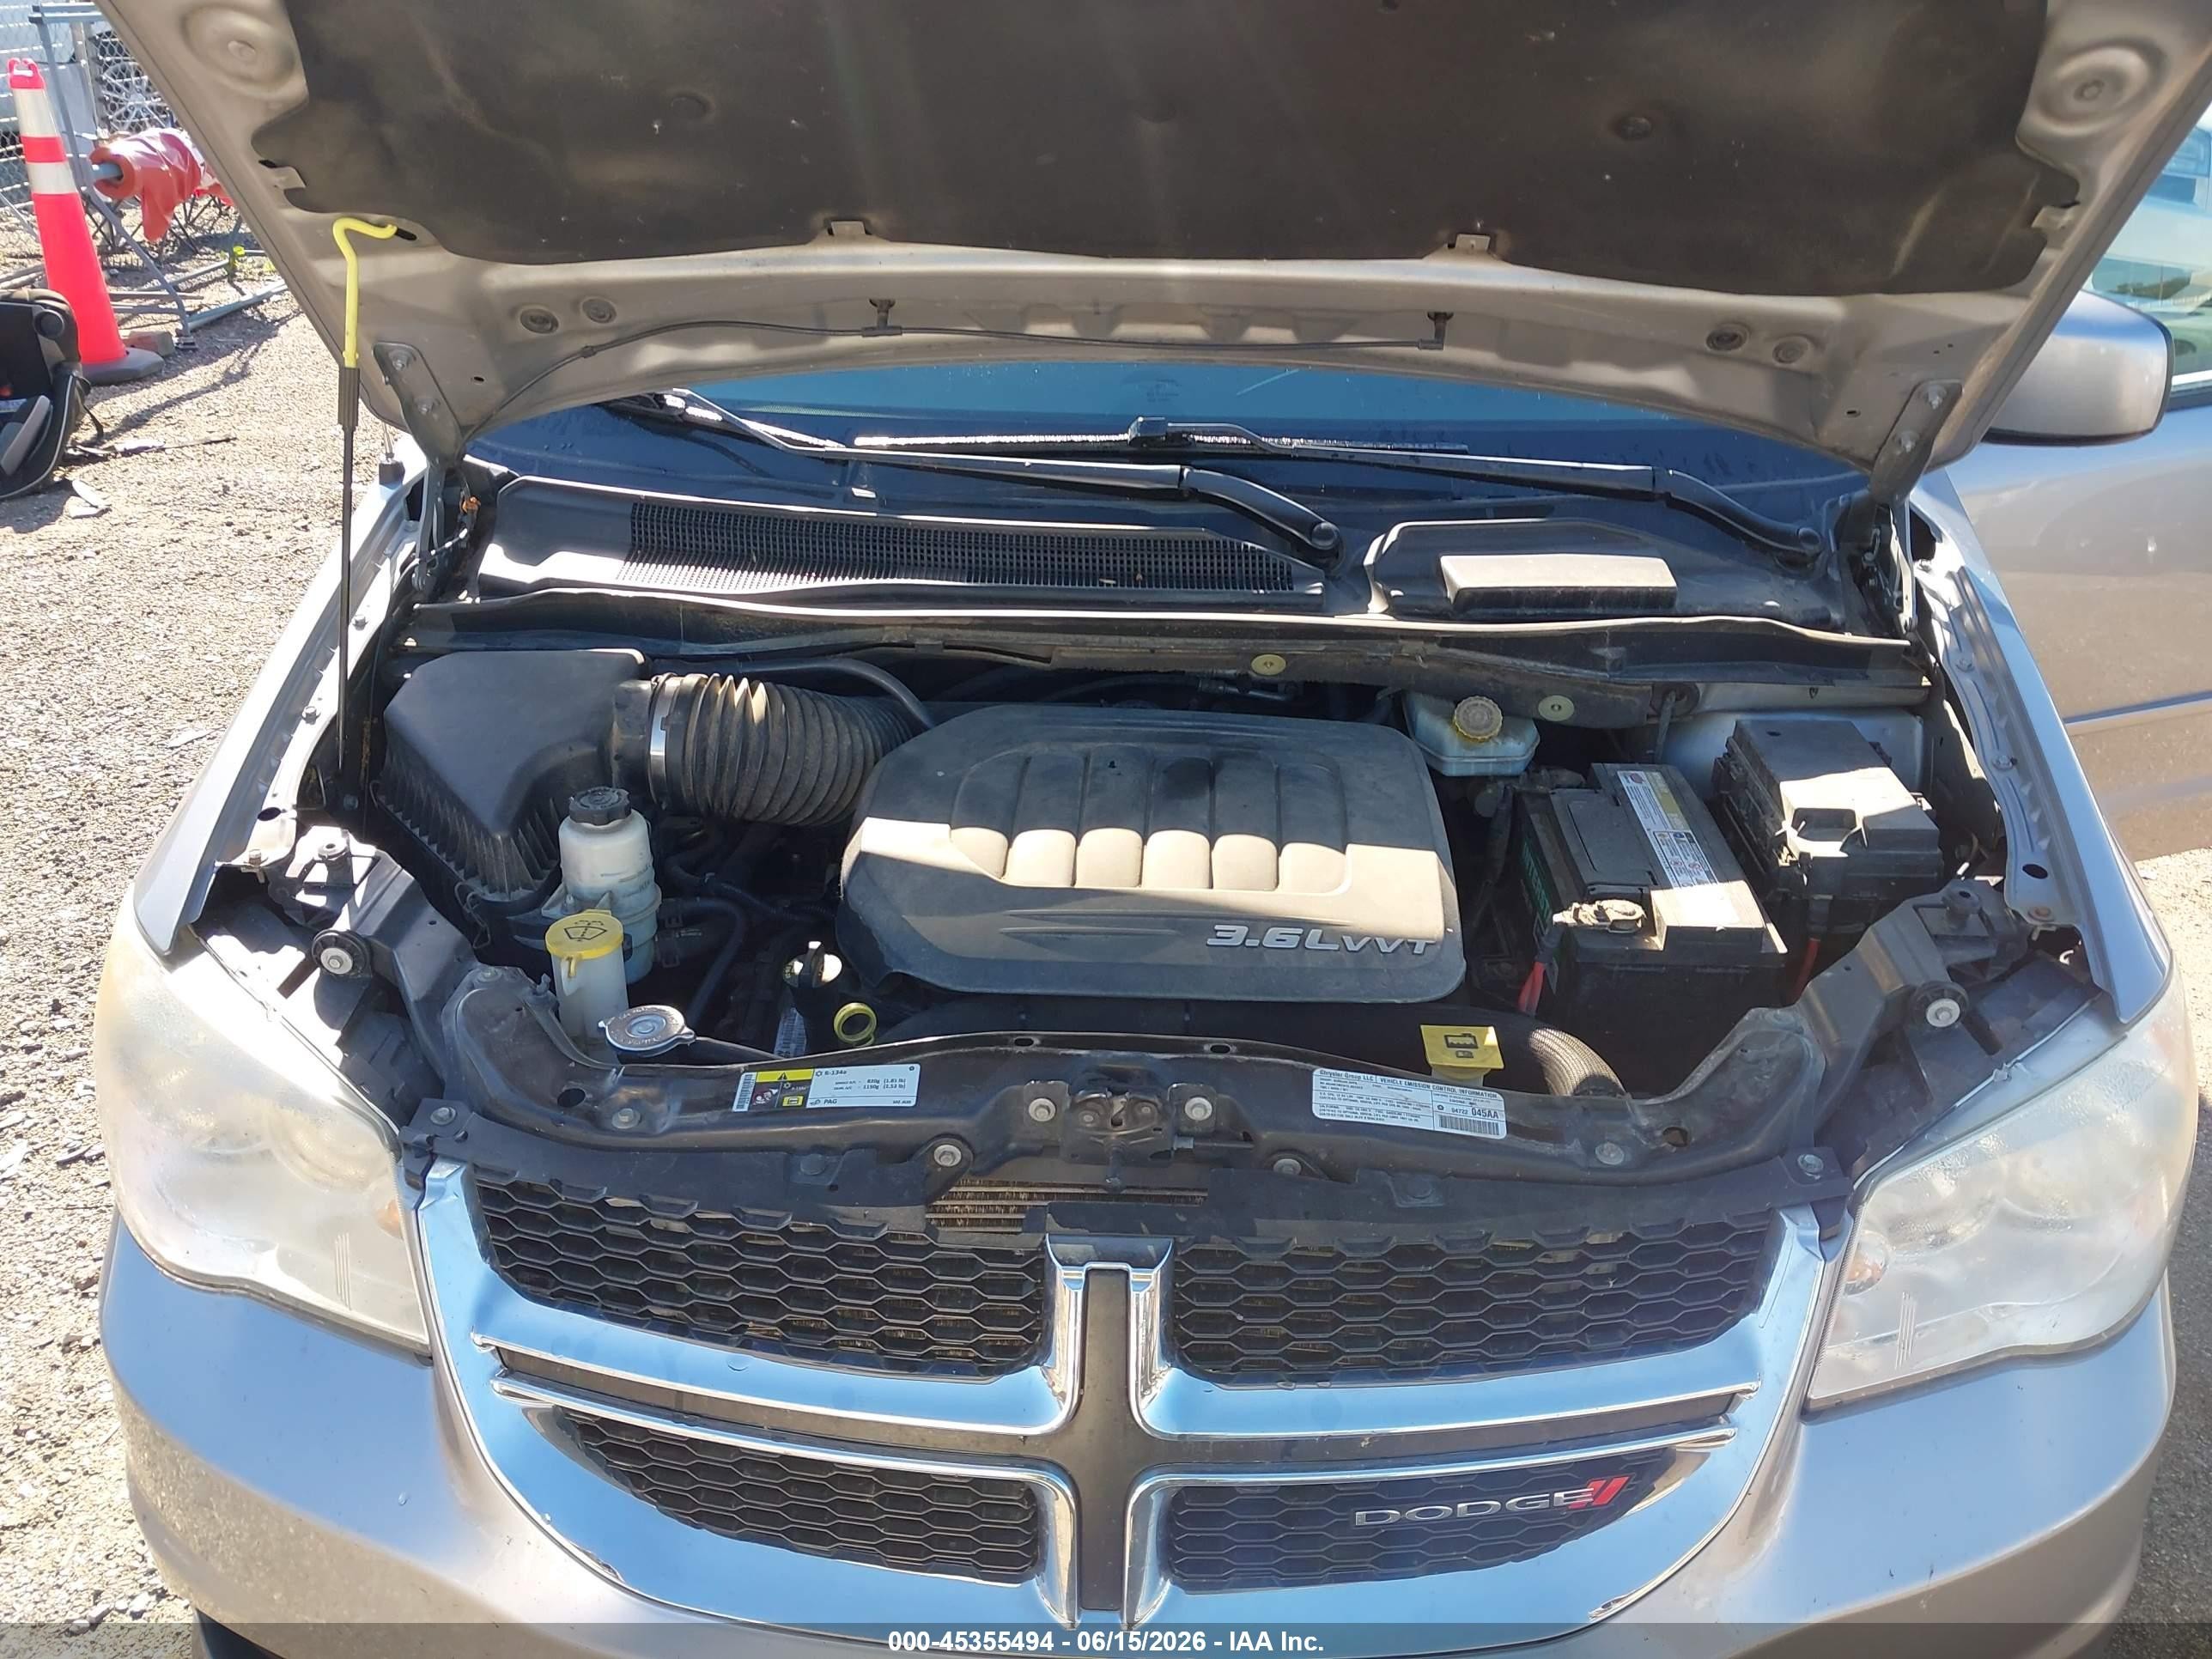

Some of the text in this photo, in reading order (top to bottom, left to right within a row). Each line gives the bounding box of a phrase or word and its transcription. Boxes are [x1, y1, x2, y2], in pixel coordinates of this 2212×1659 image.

[1404, 1081, 1431, 1090] EMISSION
[1432, 1085, 1457, 1093] CONTROL
[1459, 1088, 1498, 1098] INFORMATION
[1471, 1107, 1499, 1119] 045AA
[1355, 1487, 1595, 1526] DODGE
